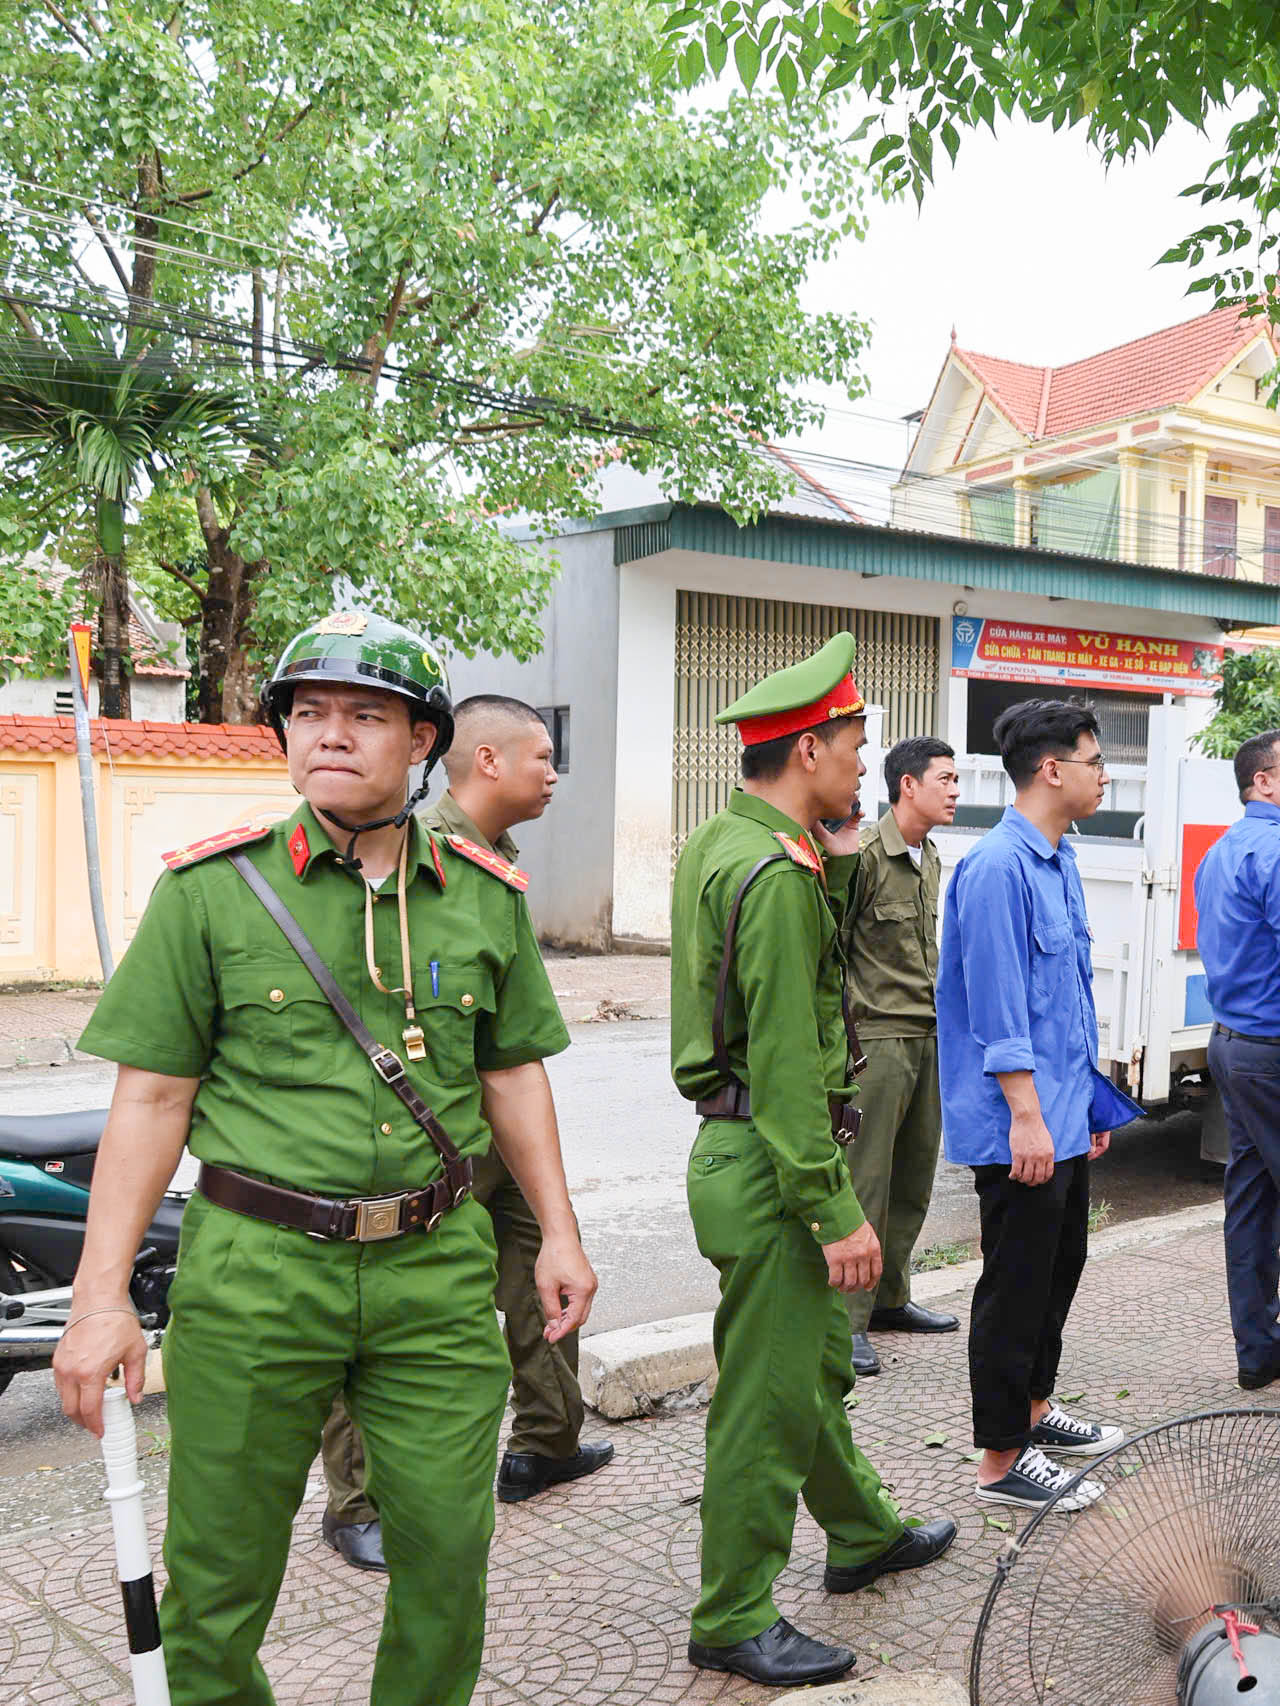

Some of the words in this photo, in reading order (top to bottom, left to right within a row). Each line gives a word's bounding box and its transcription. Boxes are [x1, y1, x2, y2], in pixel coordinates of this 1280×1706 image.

[990, 626, 1006, 637] CỬA
[1035, 632, 1045, 641] XE
[1116, 639, 1180, 656] HẠNH
[1067, 651, 1077, 663] XE
[1099, 655, 1108, 667] XE
[1125, 658, 1133, 669] XE
[1149, 660, 1158, 671] XE
[999, 665, 1037, 675] HONDA
